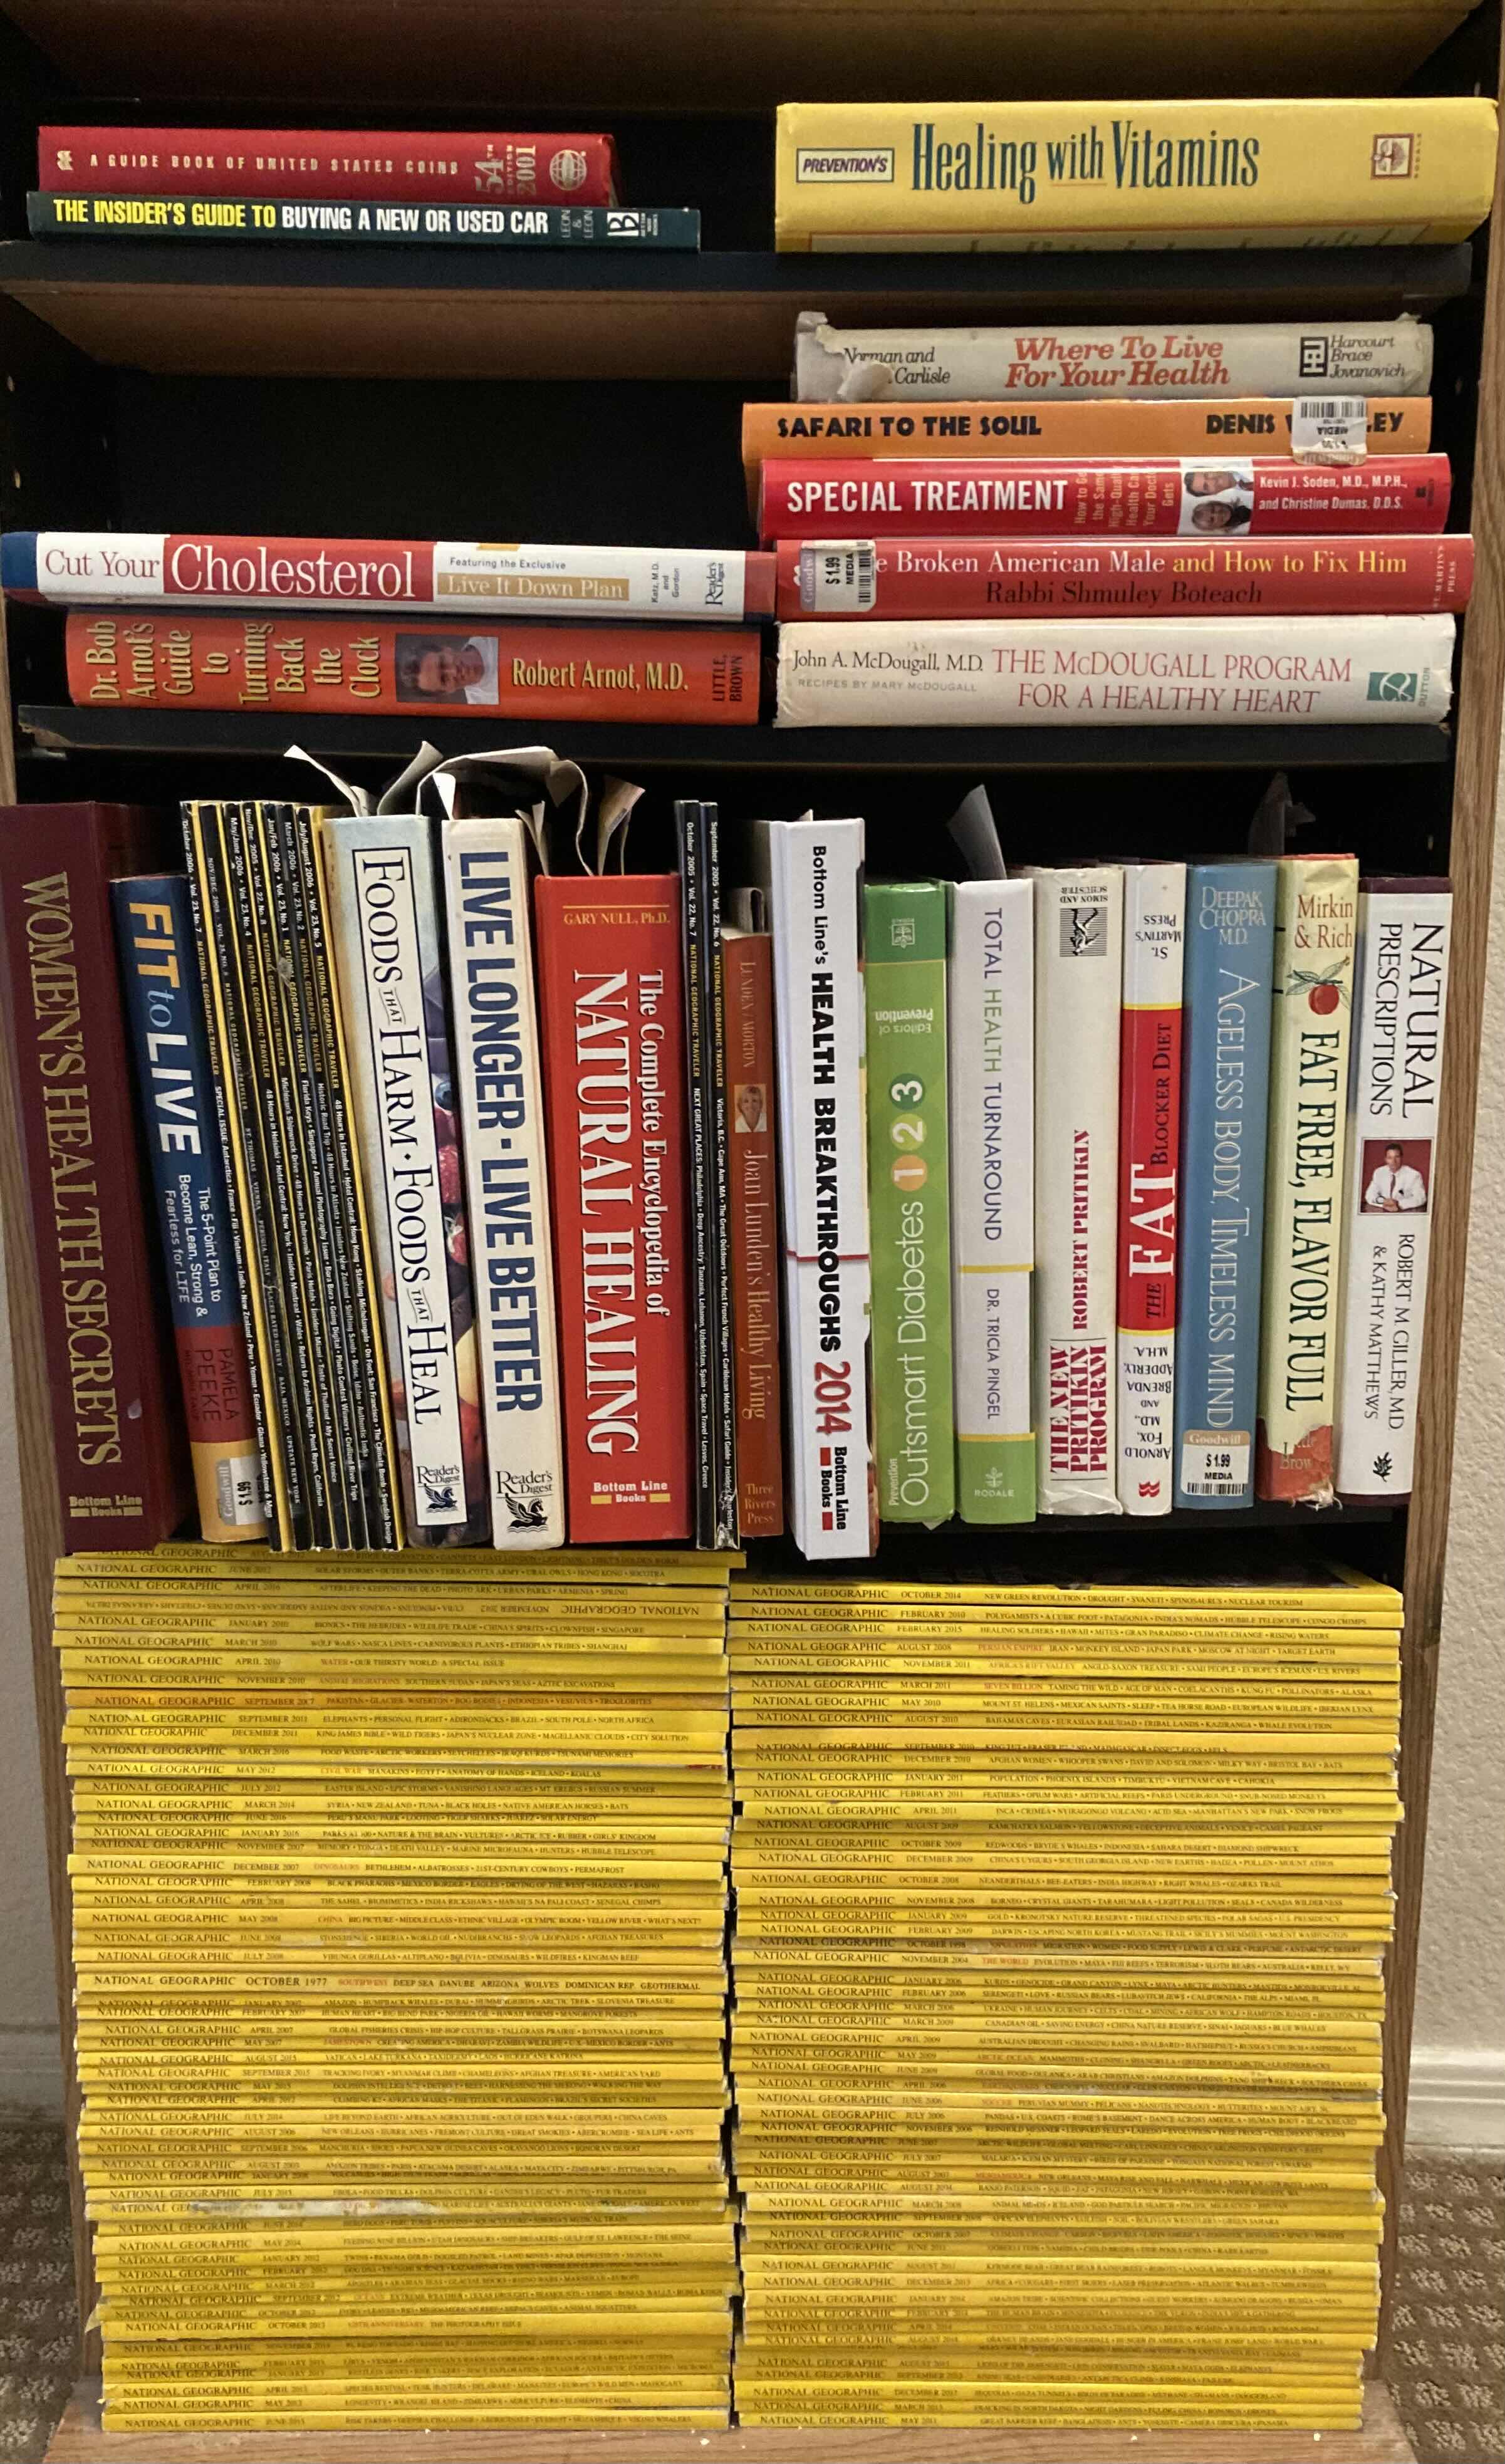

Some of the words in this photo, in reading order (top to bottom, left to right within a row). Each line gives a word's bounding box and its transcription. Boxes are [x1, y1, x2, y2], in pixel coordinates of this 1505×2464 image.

[91, 155, 98, 166] A
[108, 155, 159, 168] GUIDE
[172, 156, 214, 169] BOOK
[226, 157, 245, 170] OF
[257, 157, 318, 171] UNITED
[331, 158, 392, 172] STATES
[406, 160, 458, 174] COINS
[516, 145, 536, 195] 2001
[803, 156, 888, 173] PREVENTION'S
[912, 123, 1037, 204] Healing
[1046, 126, 1104, 180] with
[1112, 120, 1259, 188] Vitamins
[54, 200, 88, 222] THE
[94, 201, 185, 225] INSIDER'S
[192, 202, 246, 226] GUIDE
[251, 205, 276, 227] TO
[282, 206, 351, 229] BUYING
[358, 208, 370, 230] A
[376, 209, 419, 231] NEW
[426, 210, 450, 232] OR
[457, 211, 504, 232] USED
[510, 211, 548, 234] CAR
[1014, 337, 1113, 360] Where
[1120, 336, 1156, 358] To
[1162, 336, 1223, 358] Live
[1331, 335, 1395, 348] Harcourt
[1331, 350, 1372, 361] Brace
[895, 367, 950, 384] Carlisle
[1005, 363, 1056, 387] For
[1059, 362, 1125, 387] Your
[1127, 360, 1231, 385] Health
[778, 417, 872, 437] SAFARI
[880, 417, 915, 437] TO
[924, 416, 970, 436] THE
[980, 416, 1041, 437] SOUL
[787, 481, 902, 512] SPECIAL
[912, 479, 1068, 511] TREATMENT
[46, 549, 93, 576] Cut
[100, 551, 160, 578] Your
[171, 543, 415, 597] Cholesterol
[450, 558, 497, 569] Featuring
[501, 559, 516, 568] the
[519, 559, 566, 570] Exclusive
[897, 551, 979, 573] Broken
[988, 551, 1099, 573] American
[1110, 550, 1165, 573] Male
[1172, 550, 1215, 573] and
[1224, 551, 1274, 573] How
[1284, 553, 1305, 573] to
[1313, 550, 1348, 573] Fix
[1358, 550, 1407, 573] Him
[986, 581, 1054, 603] Rabbi
[1064, 581, 1160, 609] Shmuley
[1171, 581, 1262, 603] Boteach
[86, 621, 116, 665] Bob
[123, 622, 157, 700] Arnot's
[160, 630, 193, 694] Guide
[992, 649, 1046, 674] THE
[1054, 650, 1216, 678] McDOUGALL
[1224, 655, 1351, 682] PROGRAM
[90, 670, 120, 699] Dr.
[1018, 683, 1069, 708] FOR
[1078, 685, 1094, 709] A
[1103, 685, 1227, 711] HEALTHY
[1232, 689, 1321, 712] HEART
[1419, 667, 1430, 707] DUTTON
[460, 851, 515, 947] LIVE
[813, 846, 827, 909] Bottom
[362, 856, 405, 983] FOODS
[815, 915, 828, 965] Line's
[984, 907, 1002, 979] TOTAL
[129, 902, 180, 988] FIT
[197, 940, 206, 984] NATIONAL
[22, 871, 86, 1076] WOMEN'S
[638, 969, 663, 1017] The
[147, 989, 174, 1028] to
[201, 985, 214, 1036] GEOGRAPHIC
[383, 989, 403, 1024] THAT
[811, 972, 835, 1085] HEALTH
[875, 1007, 933, 1022] Prevention
[1369, 922, 1403, 1116] PRESCRIPTIONS
[1402, 922, 1445, 1119] NATURAL
[466, 958, 525, 1130] LONGER
[984, 990, 1002, 1073] HEALTH
[1215, 969, 1261, 1111] AGELESS
[209, 1037, 220, 1076] TRAVELER
[637, 1024, 665, 1133] Complete
[1299, 1029, 1340, 1092] FAT
[147, 1032, 201, 1154] LIVE
[379, 1026, 422, 1148] HARM
[575, 969, 633, 1215] NATURAL
[984, 1083, 1002, 1240] TURNAROUND
[1211, 1120, 1242, 1203] BODY,
[1288, 1099, 1336, 1188] FREE,
[43, 1084, 105, 1271] HEALTH
[179, 1174, 192, 1222] Become
[640, 1139, 669, 1287] Encyclopedia
[814, 1098, 841, 1353] BREAKTHROUGHS
[184, 1229, 197, 1261] Lean,
[1289, 1197, 1332, 1324] FLAVOR
[190, 1263, 204, 1304] Strong
[895, 1201, 927, 1343] Diabetes
[1207, 1207, 1249, 1343] TIMELESS
[646, 1294, 670, 1316] of
[582, 1227, 639, 1456] HEALING
[61, 1279, 122, 1466] SECRETS
[1207, 1354, 1236, 1428] MIND
[1286, 1331, 1326, 1411] FULL
[815, 1361, 852, 1436] 2014
[897, 1353, 929, 1506] Outsmart
[1189, 1433, 1241, 1444] Goodwill
[974, 1489, 1014, 1498] RODALE
[1204, 1472, 1232, 1480] MEDIA
[752, 1588, 811, 1598] NATIONAL
[815, 1589, 888, 1599] GEOGRAPHIC
[75, 1636, 134, 1646] NATIONAL
[137, 1637, 213, 1647] GEOGRAPHIC
[224, 1638, 256, 1646] MARCH
[752, 1697, 812, 1707] NATIONAL
[816, 1697, 889, 1707] GEOGRAPHIC
[752, 1951, 811, 1960] NATIONAL
[815, 1952, 889, 1963] GEOGRAPHIC
[95, 1975, 154, 1985] NATIONAL
[160, 1976, 236, 1985] GEOGRAPHIC
[246, 1977, 300, 1986] OCTOBER
[305, 1977, 327, 1987] 1977
[393, 1979, 416, 1987] DEEP
[419, 1979, 434, 1987] SEA
[440, 1980, 475, 1988] DANUBE
[481, 1980, 519, 1988] ARIZONA
[524, 1981, 559, 1989] WOLVES
[565, 1981, 615, 1990] DOMINICAN
[640, 1982, 700, 1990] GEOTHERMAL
[756, 1986, 813, 1996] NATIONAL
[816, 1987, 892, 1997] GEOGRAPHIC
[124, 2400, 179, 2409] NATIONAL
[184, 2400, 254, 2409] GEOGRAPHIC
[754, 2388, 807, 2396] NATIONAL
[813, 2388, 883, 2397] GEOGRAPHIC
[761, 2415, 816, 2425] NATIONAL
[819, 2416, 888, 2425] GEOGRAPHIC
